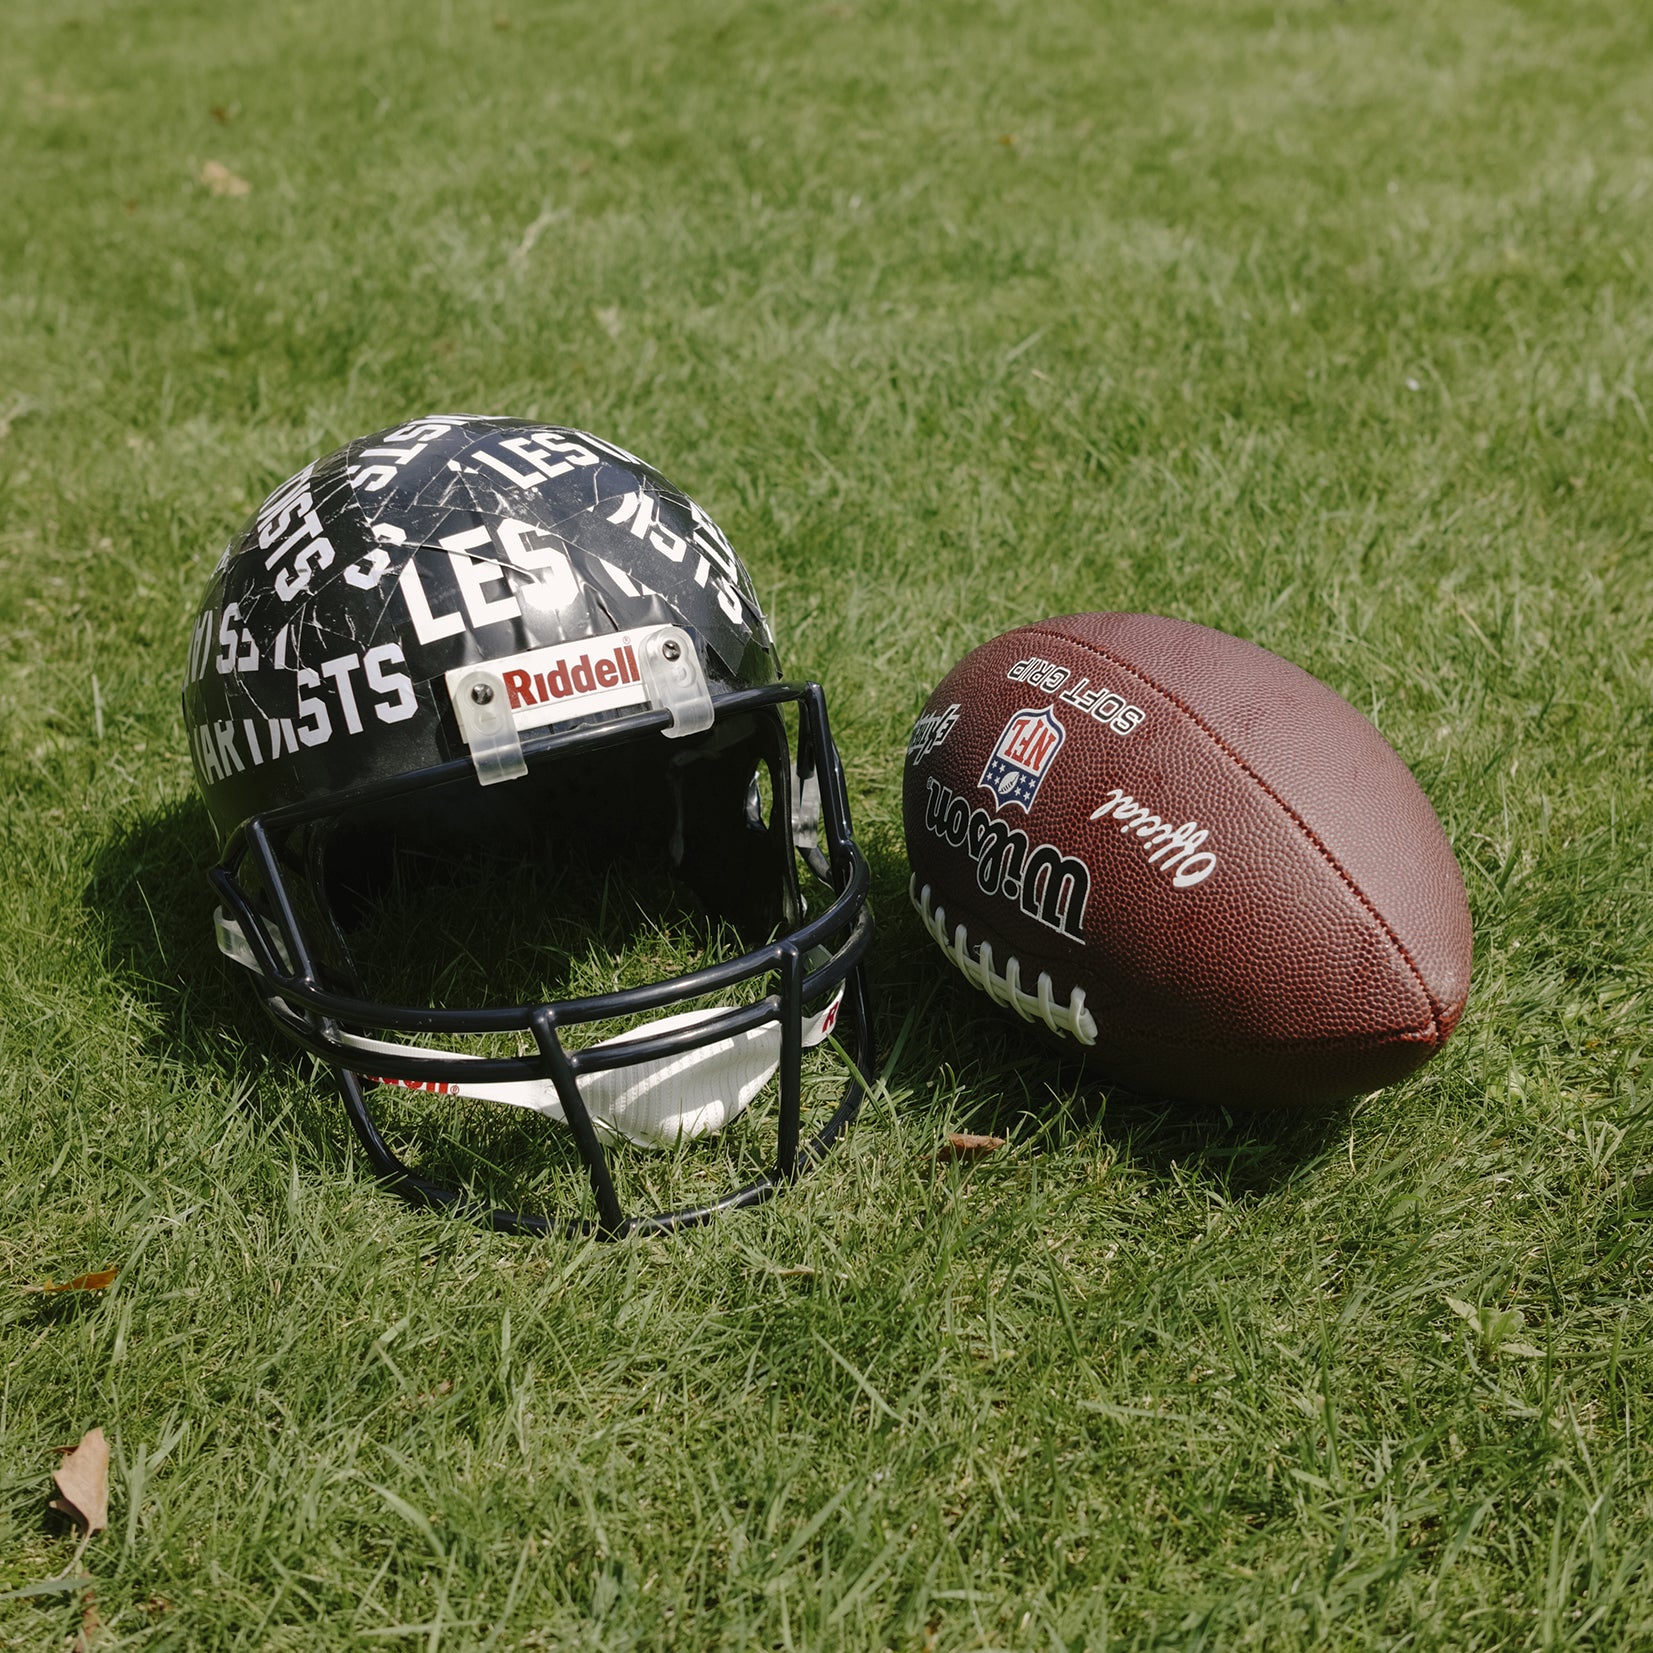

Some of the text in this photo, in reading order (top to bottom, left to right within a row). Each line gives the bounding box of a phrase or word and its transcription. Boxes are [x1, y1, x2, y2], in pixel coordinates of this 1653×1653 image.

[471, 432, 600, 490] LES
[398, 517, 580, 646] LES
[502, 645, 641, 710] Riddell
[1006, 656, 1147, 736] SOFT GRIP
[1001, 719, 1057, 772] NFL
[925, 777, 1087, 946] Wilson
[1089, 788, 1218, 889] Official
